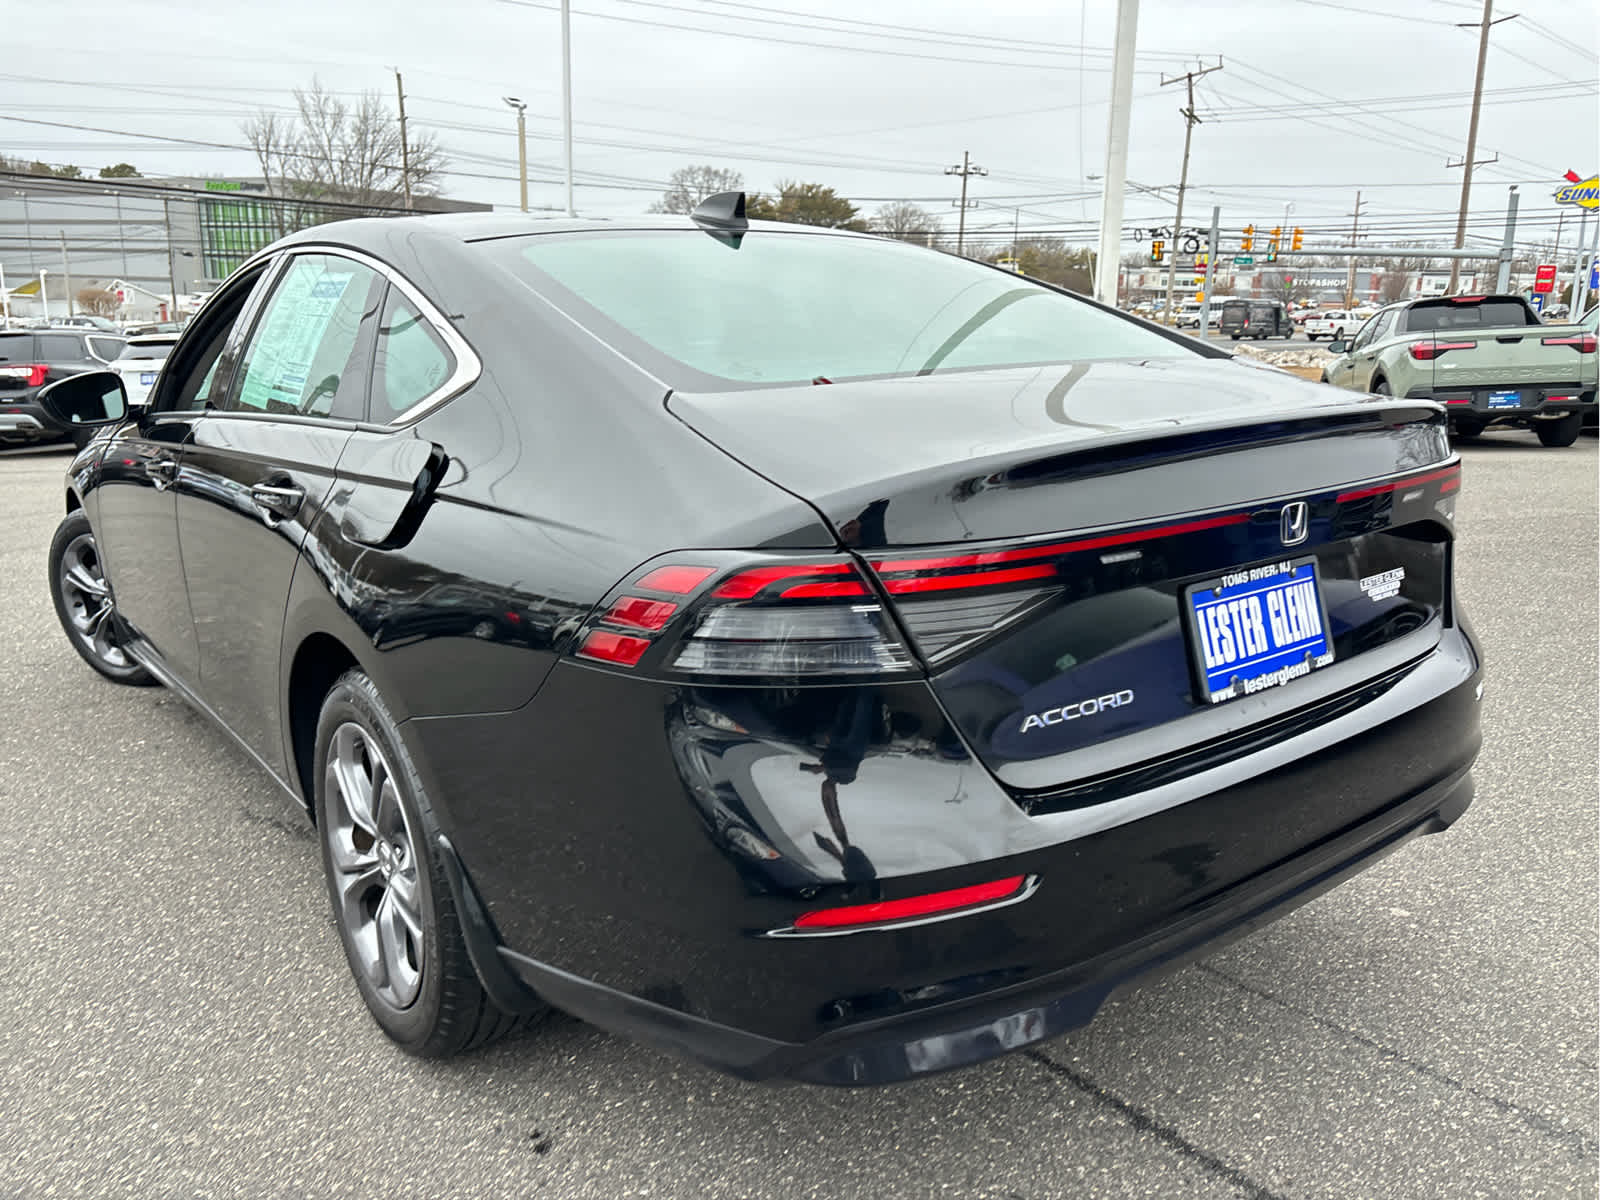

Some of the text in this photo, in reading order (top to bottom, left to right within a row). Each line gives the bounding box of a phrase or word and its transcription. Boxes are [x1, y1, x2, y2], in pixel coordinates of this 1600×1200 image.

[1221, 571, 1249, 588] TOMS
[1279, 561, 1292, 574] NJ
[1196, 580, 1322, 670] LESTER GLENN
[1020, 689, 1134, 733] ACCORD
